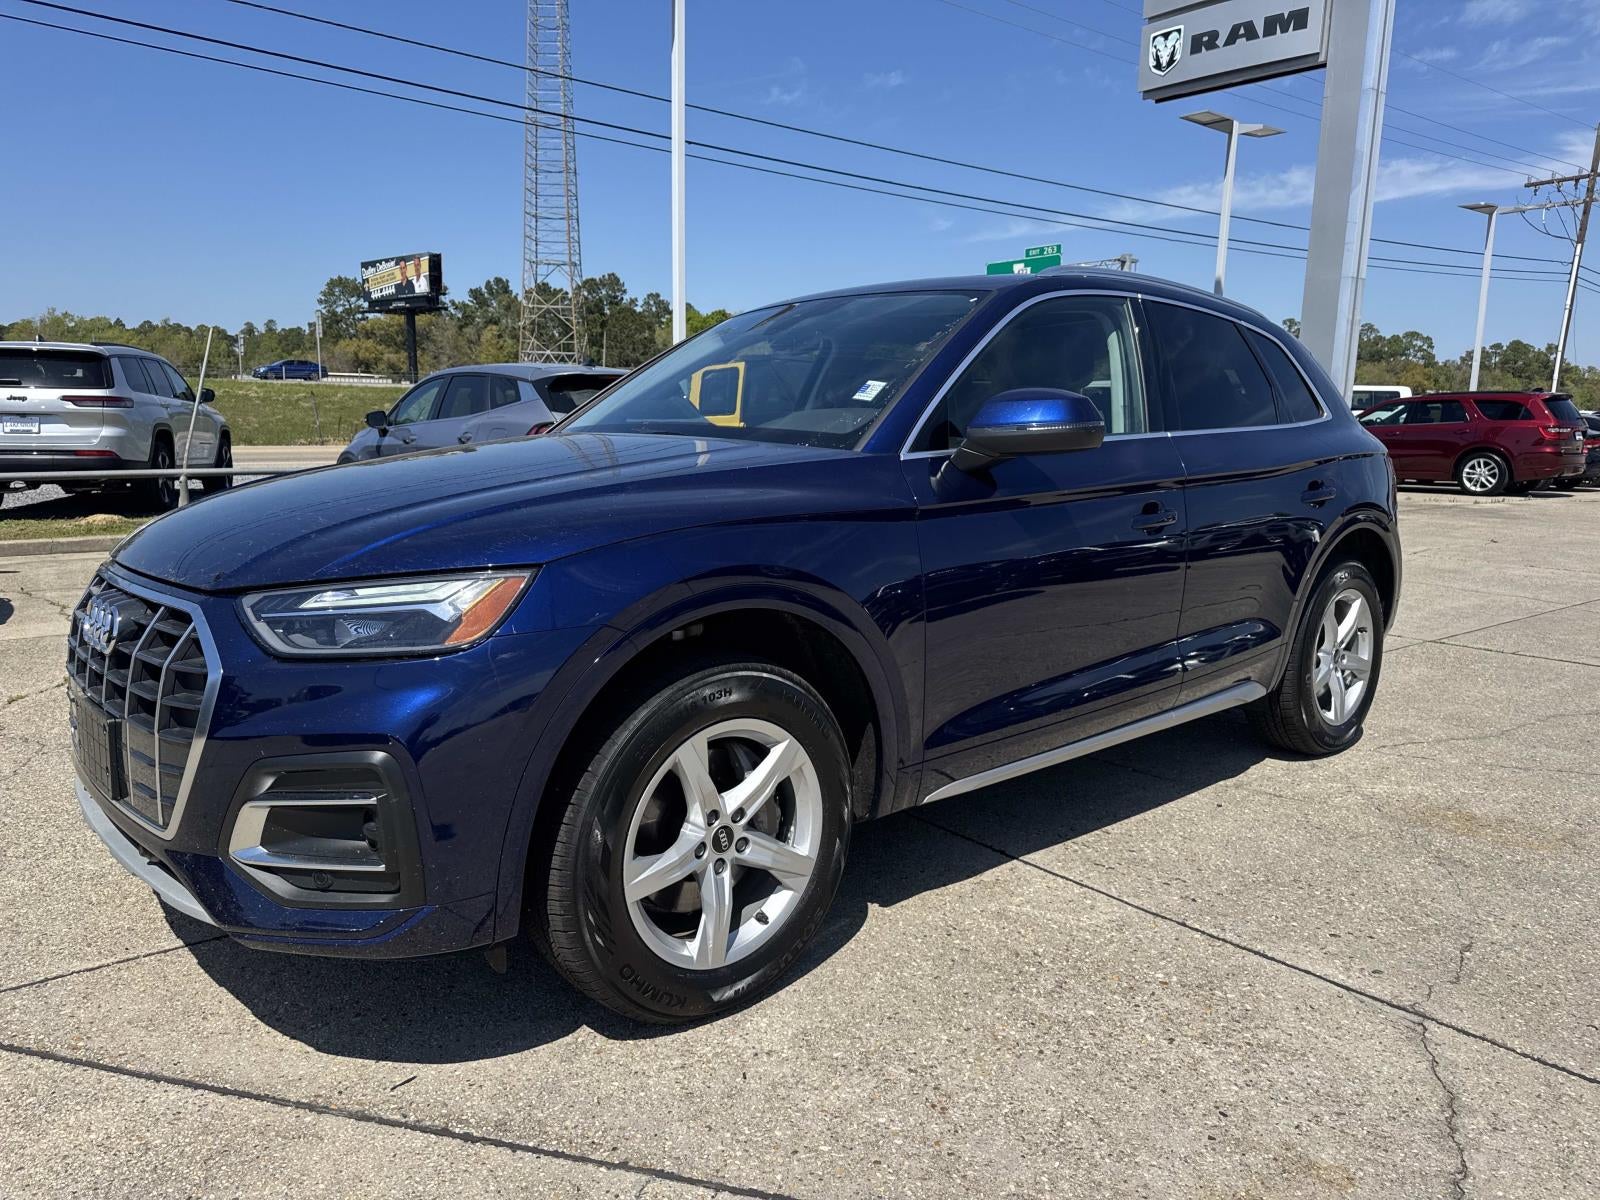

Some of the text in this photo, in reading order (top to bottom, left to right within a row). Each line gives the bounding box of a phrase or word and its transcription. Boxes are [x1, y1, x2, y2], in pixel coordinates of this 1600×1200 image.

[1190, 7, 1310, 56] RAM
[1043, 246, 1057, 255] 263
[6, 394, 28, 402] Jeep
[702, 687, 733, 704] 103H
[619, 964, 688, 1009] KUMHO
